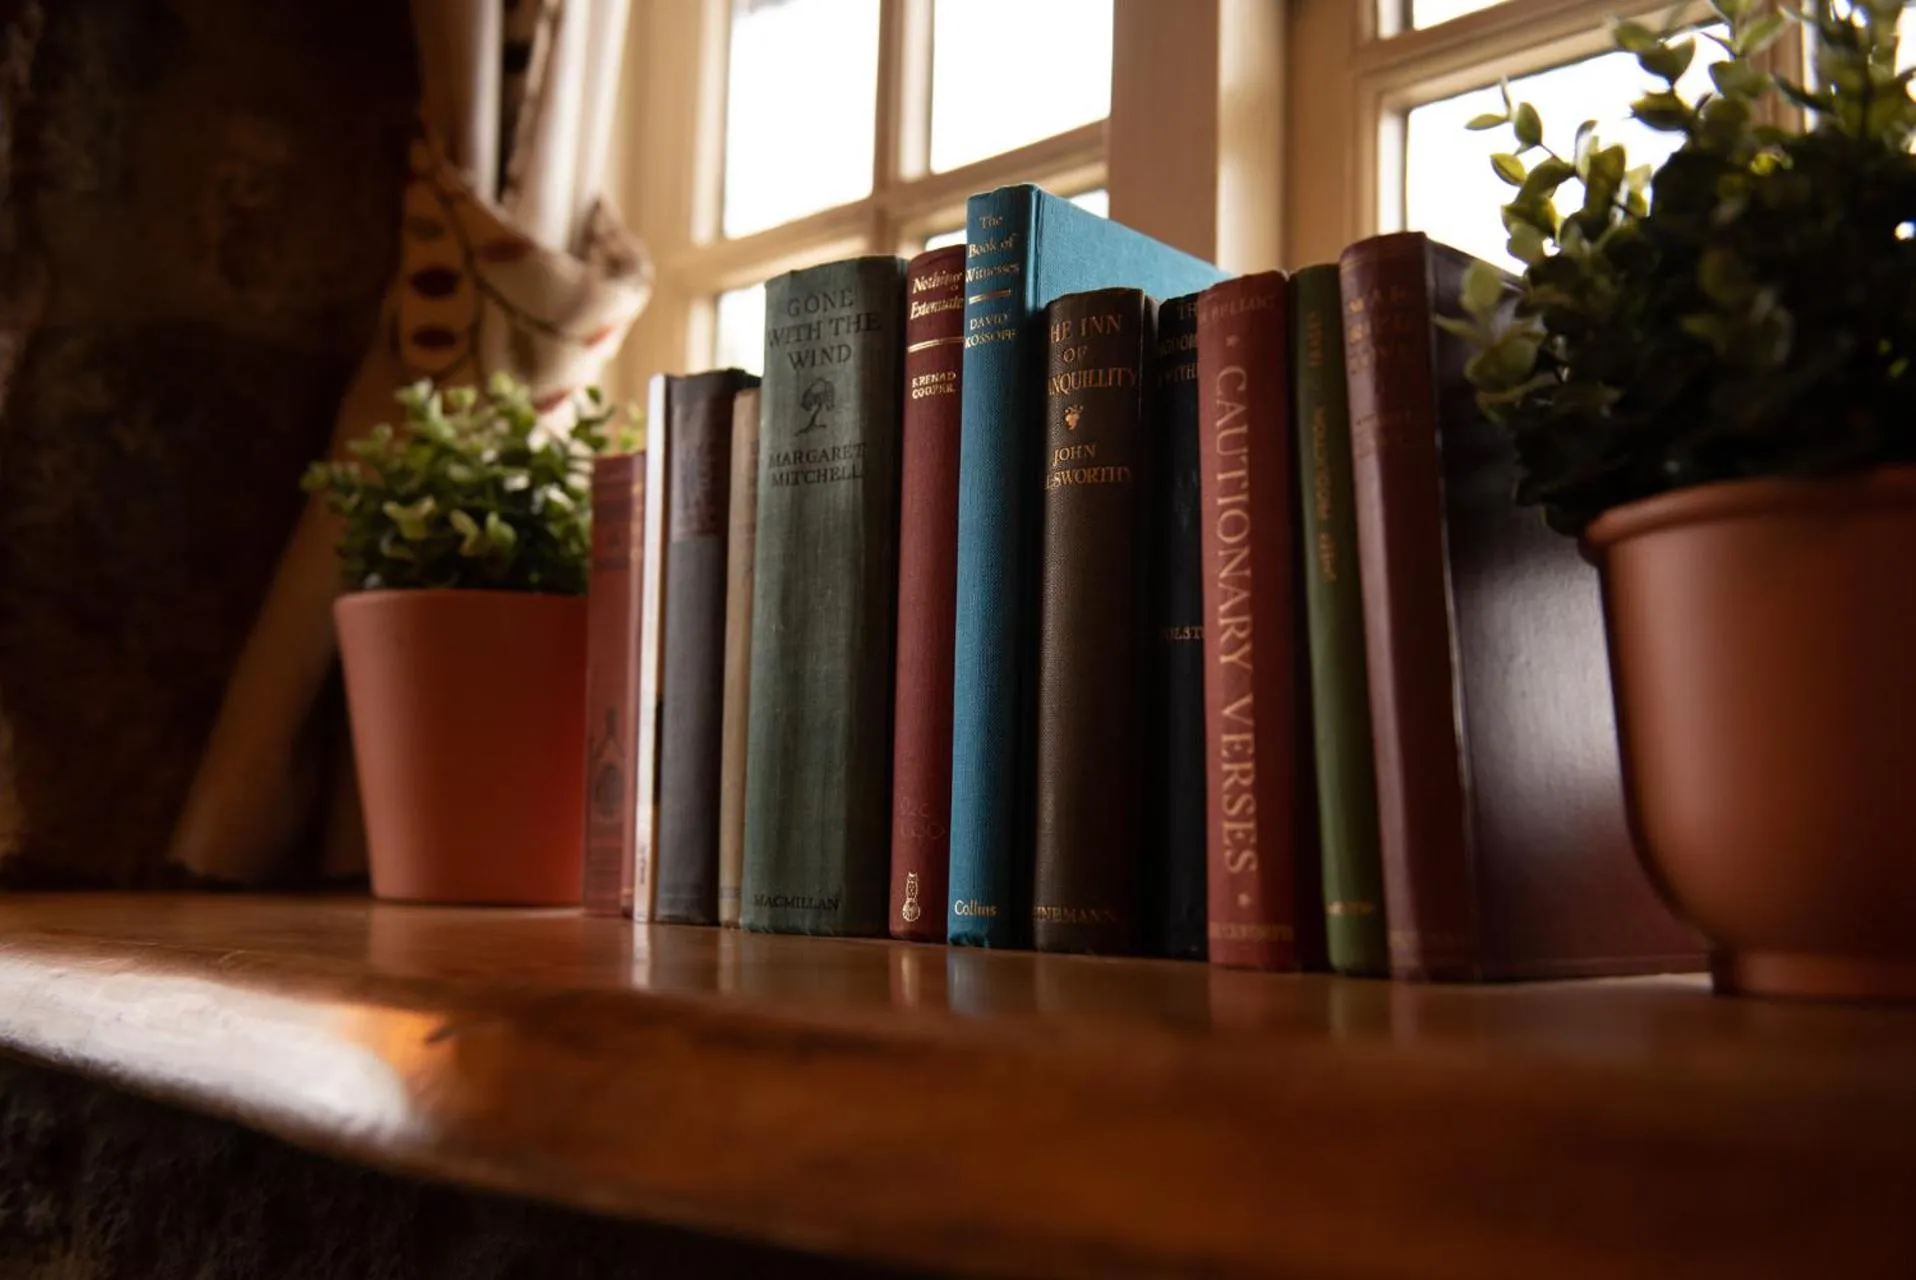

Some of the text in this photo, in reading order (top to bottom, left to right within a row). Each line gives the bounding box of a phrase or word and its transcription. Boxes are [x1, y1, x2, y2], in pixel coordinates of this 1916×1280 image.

[978, 215, 1004, 229] The
[967, 232, 1018, 258] Book of
[786, 288, 855, 318] GONE
[768, 311, 882, 347] WITH THE
[969, 313, 1008, 331] DAVID
[1080, 313, 1124, 337] INN
[787, 343, 853, 371] WIND
[1062, 345, 1089, 362] OF
[1048, 366, 1139, 396] NQUILLITY
[767, 443, 869, 469] MARGARET
[1052, 444, 1096, 467] JOHN
[770, 464, 865, 488] MITCHELL
[1215, 365, 1258, 874] CAUTIONARY VERSES
[753, 894, 840, 911] MACMILLAN
[953, 899, 998, 918] Collins
